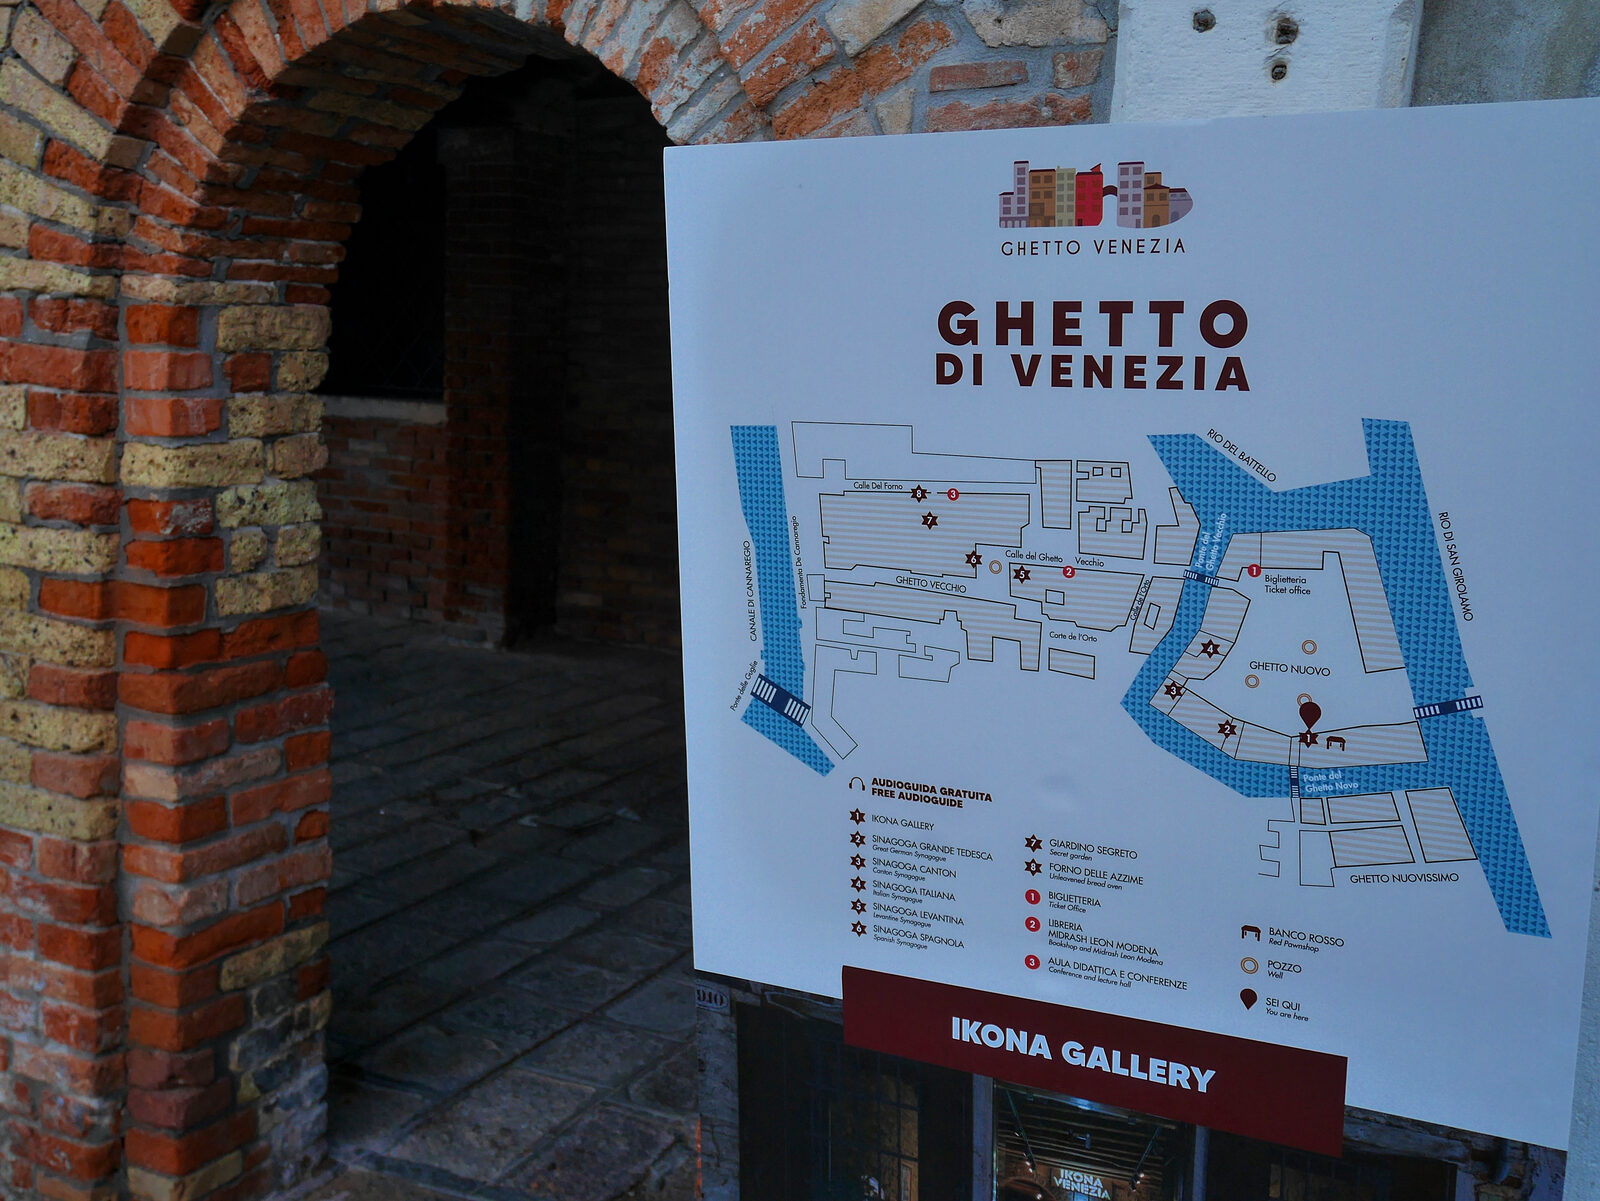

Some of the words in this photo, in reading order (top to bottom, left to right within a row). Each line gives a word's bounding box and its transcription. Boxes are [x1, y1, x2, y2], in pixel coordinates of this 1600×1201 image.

[1001, 240, 1081, 256] GHETTO
[1094, 238, 1185, 254] VENEZIA
[937, 299, 1248, 349] GHETTO
[935, 353, 983, 386] DI
[1010, 354, 1250, 391] VENEZIA
[1206, 428, 1224, 444] RIO
[1222, 440, 1237, 456] DEL
[1238, 452, 1277, 482] BATTELLO
[854, 482, 870, 490] Calle
[884, 482, 903, 490] Forno
[1438, 512, 1451, 530] RIO
[1206, 544, 1219, 571] Ghetto
[1213, 513, 1227, 542] Vecchio
[1443, 531, 1454, 542] DI
[1194, 548, 1208, 568] Ponte
[1202, 531, 1211, 544] del
[1446, 544, 1460, 566] SAN
[1006, 550, 1025, 560] Calle
[1026, 551, 1036, 560] del
[1038, 552, 1064, 563] Ghetto
[1075, 556, 1104, 568] Vecchio
[743, 540, 754, 598] CANNAREGIO
[896, 576, 928, 587] GHETTO
[930, 580, 966, 593] VECCHIO
[1264, 574, 1306, 584] Biglietteria
[1264, 585, 1288, 594] Ticket
[1289, 585, 1311, 595] office
[1452, 568, 1474, 622] GIROLAMO
[748, 600, 754, 608] DI
[748, 610, 758, 642] CANALE
[1049, 631, 1067, 640] Corte
[1068, 632, 1077, 640] de
[1078, 633, 1098, 642] l'Orto
[1250, 661, 1288, 672] GHETTO
[1290, 665, 1330, 677] NUOVO
[730, 696, 742, 712] Ponte
[738, 680, 748, 695] delle
[744, 660, 758, 680] Guglie
[1303, 773, 1326, 782] Ponte
[1328, 771, 1342, 780] del
[872, 777, 938, 794] AUDIOGUIDA
[940, 786, 993, 802] GRATUITA
[1305, 782, 1334, 792] Ghetto
[1336, 781, 1359, 790] Novo
[871, 788, 896, 800] FREE
[898, 791, 964, 808] AUDIOGUIDE
[872, 814, 898, 826] IKONA
[900, 818, 935, 831] GALLERY
[872, 834, 918, 849] SINAGOGA
[920, 842, 954, 856] GRANDE
[956, 848, 994, 862] TEDESCA
[872, 844, 889, 854] Great
[890, 846, 913, 857] German
[914, 850, 947, 863] Synagogue
[1050, 838, 1095, 853] GIARDINO
[1096, 846, 1138, 860] SEGRETO
[1050, 849, 1068, 858] Secret
[1070, 852, 1092, 862] garden
[872, 857, 918, 872] SINAGOGA
[920, 865, 957, 878] CANTON
[872, 867, 893, 876] Canton
[894, 870, 926, 882] Synagogue
[1050, 862, 1082, 876] FORNO
[1084, 868, 1108, 880] DELLE
[1110, 872, 1144, 886] AZZIME
[1049, 874, 1086, 885] Unleavened
[1087, 878, 1106, 888] bread
[1107, 882, 1123, 890] oven
[1350, 873, 1390, 884] GHETTO
[1392, 872, 1460, 883] NUOVISSIMO
[872, 880, 918, 895] SINAGOGA
[920, 887, 956, 902] ITALIANA
[872, 890, 890, 899] Italian
[891, 892, 923, 904] Synagogue
[1048, 891, 1102, 908] BIGLIETTERIA
[872, 902, 918, 918] SINAGOGA
[920, 910, 964, 926] LEVANTINA
[1048, 901, 1066, 910] Ticket
[1067, 904, 1086, 914] Office
[873, 912, 898, 922] Levantine
[900, 916, 932, 928] Synagogue
[1048, 919, 1083, 932] LIBRERIA
[873, 924, 918, 940] SINAGOGA
[920, 933, 964, 948] SPAGNOLA
[873, 934, 896, 944] Spanish
[896, 938, 928, 950] Synagogue
[1048, 930, 1088, 944] MIDRASH
[1090, 936, 1114, 948] LEON
[1116, 942, 1158, 956] MODENA
[1269, 927, 1306, 941] BANCO
[1309, 933, 1345, 947] ROSSO
[1269, 937, 1282, 947] Red
[1284, 940, 1320, 953] Pawnshop
[1048, 938, 1078, 952] Bookshop
[1079, 945, 1092, 953] and
[1093, 947, 1119, 958] Midrash
[1120, 951, 1135, 961] Leon
[1136, 955, 1164, 966] Modena
[1048, 957, 1072, 968] AULA
[1073, 961, 1118, 978] DIDATTICA
[1120, 970, 1125, 979] E
[1127, 972, 1188, 990] CONFERENZE
[1267, 959, 1302, 974] POZZO
[1267, 970, 1284, 980] Well
[1048, 966, 1083, 980] Conference
[1083, 974, 1096, 982] and
[1098, 976, 1118, 986] lecture
[1120, 979, 1132, 988] hall
[1266, 997, 1280, 1008] SEI
[1282, 1000, 1300, 1012] QUI
[1266, 1008, 1278, 1016] You
[1293, 1013, 1309, 1022] here
[951, 1016, 1052, 1060] IKONA
[1060, 1040, 1216, 1094] GALLERY
[1060, 1168, 1104, 1188] IKONA
[1053, 1176, 1111, 1200] VENEZIA
